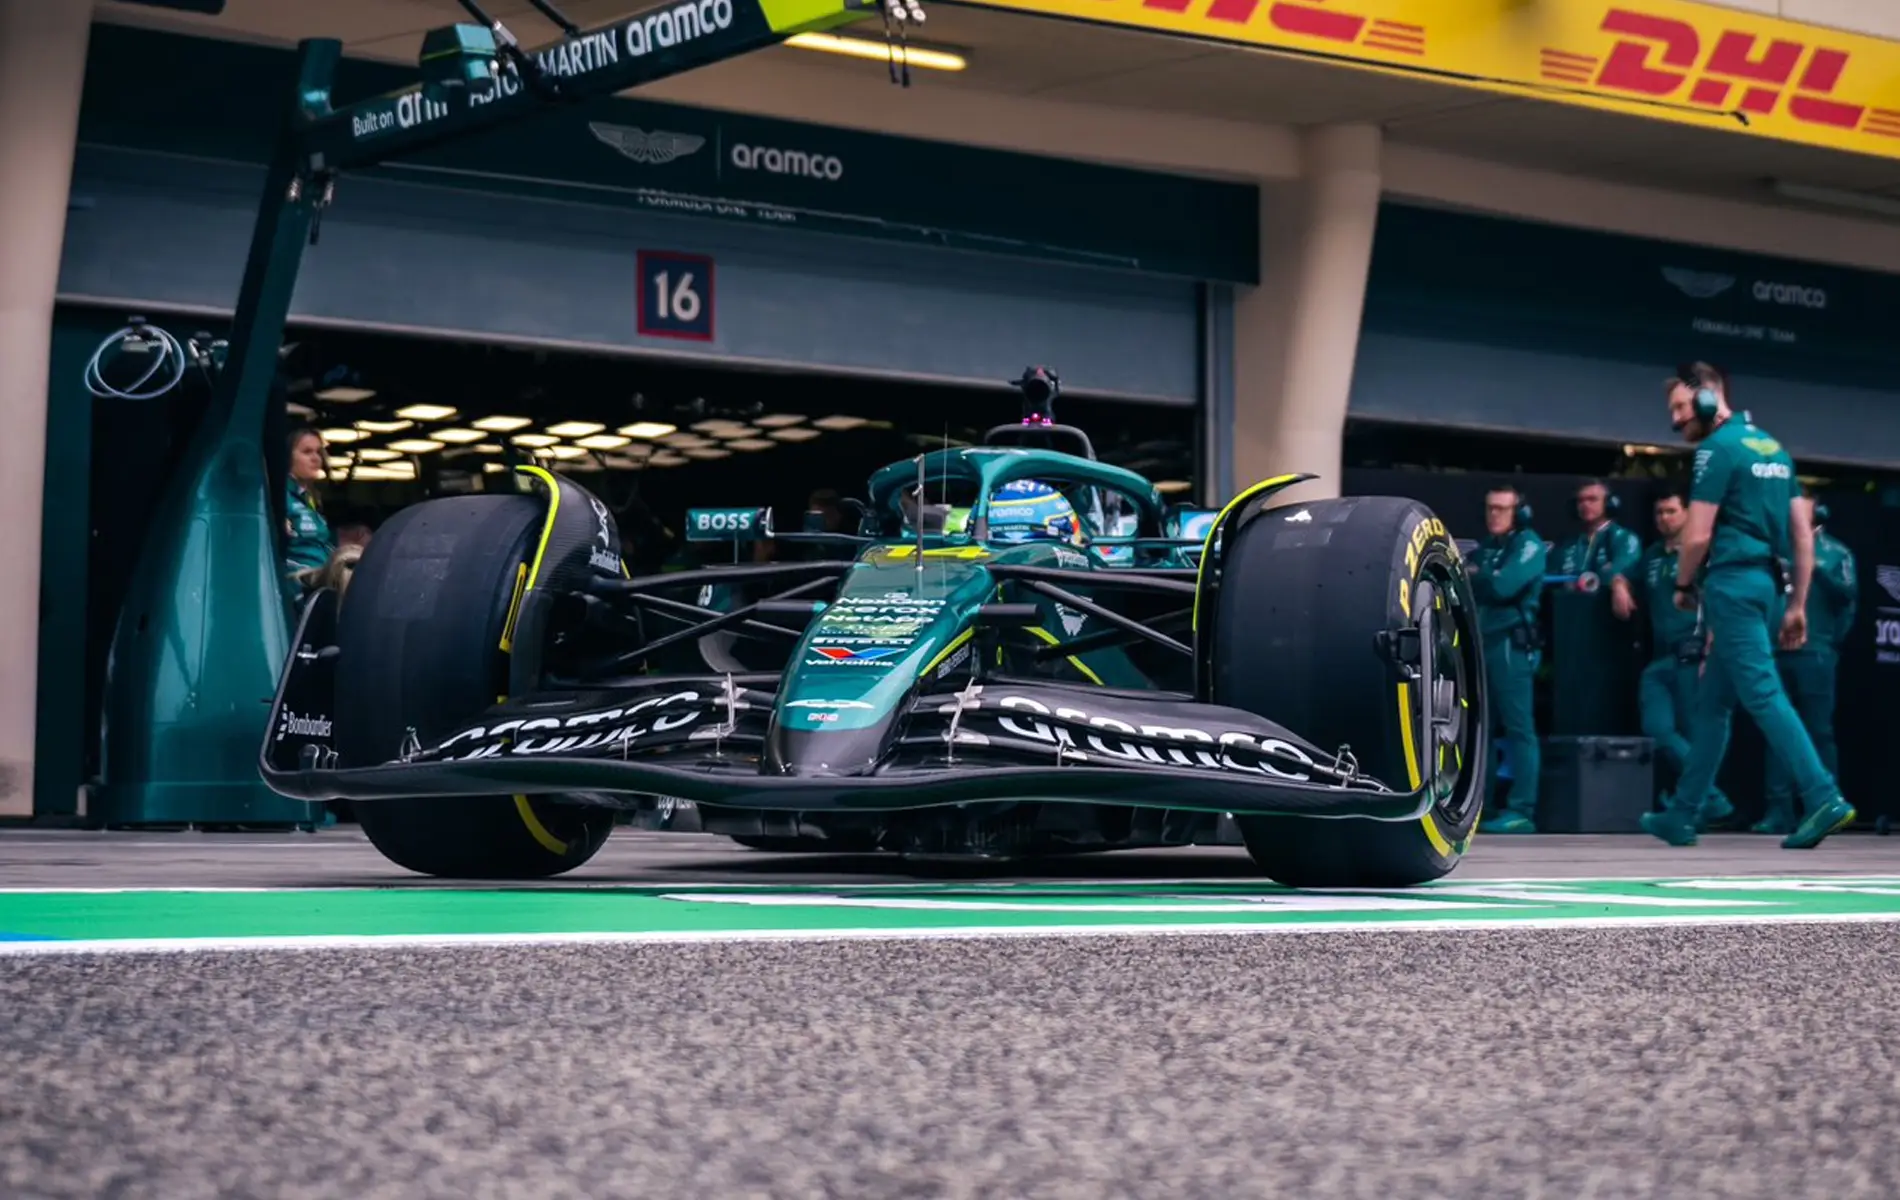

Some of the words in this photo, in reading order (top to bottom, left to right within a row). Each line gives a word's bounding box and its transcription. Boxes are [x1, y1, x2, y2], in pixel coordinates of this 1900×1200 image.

[353, 111, 379, 137] Built
[379, 110, 394, 129] on
[626, 0, 733, 57] aramco
[1595, 8, 1866, 129] DHL
[731, 143, 843, 180] aramco
[654, 270, 701, 322] 16
[1752, 280, 1825, 308] aramco
[697, 513, 751, 530] BOSS
[1405, 518, 1445, 579] ZERO
[821, 615, 934, 624] NetApp
[836, 597, 947, 606] NexGen
[805, 659, 897, 667] Valvoline
[998, 696, 1314, 782] aramco
